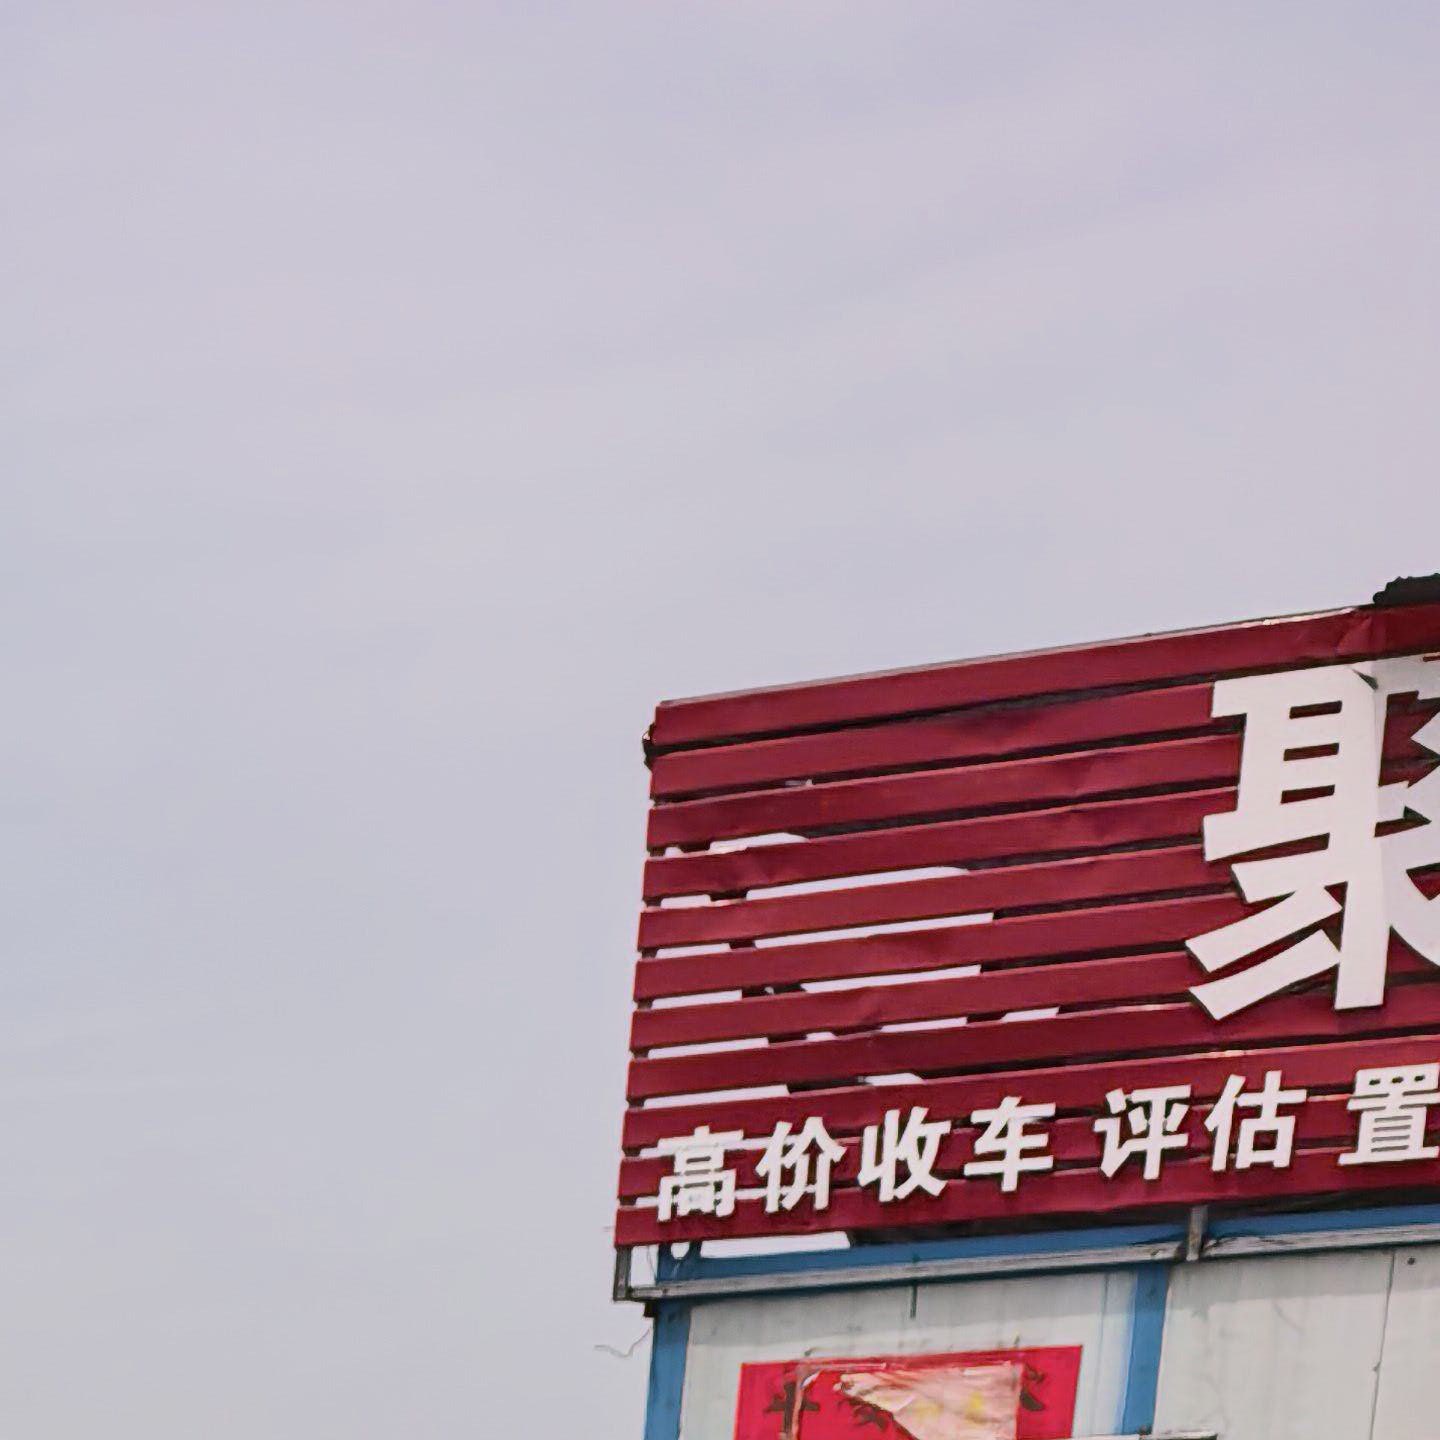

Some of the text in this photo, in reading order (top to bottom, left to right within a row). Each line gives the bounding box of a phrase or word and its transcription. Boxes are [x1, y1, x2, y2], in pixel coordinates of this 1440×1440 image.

[1185, 655, 1440, 1021] 聚
[656, 1062, 1440, 1223] 高价收车 评估 置
